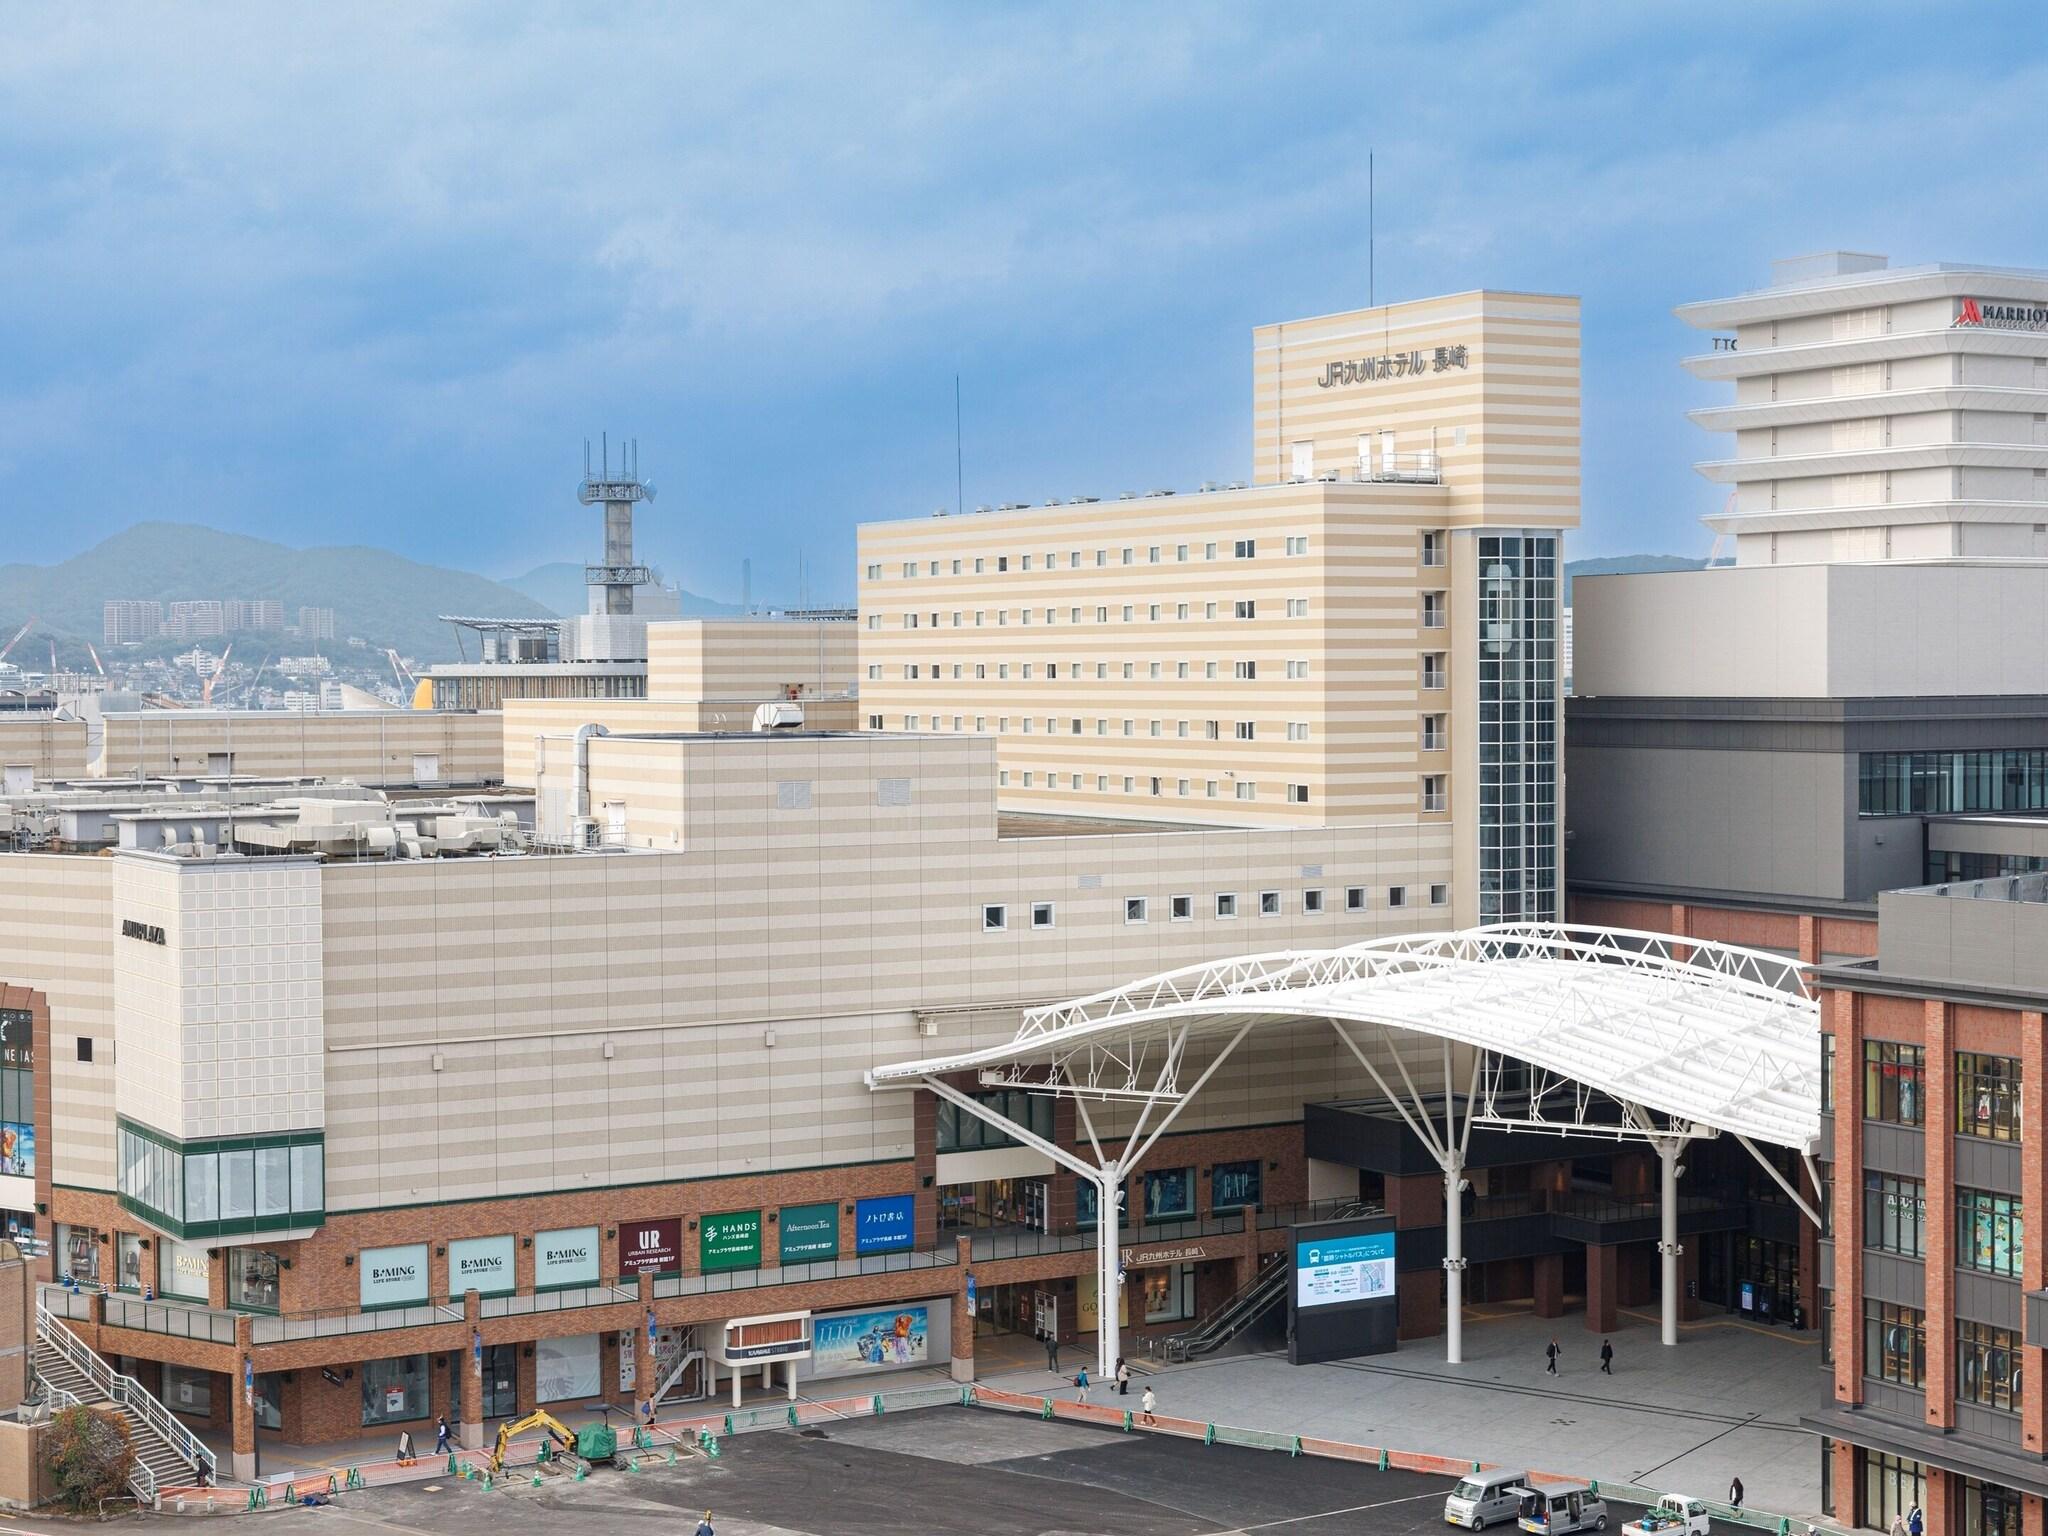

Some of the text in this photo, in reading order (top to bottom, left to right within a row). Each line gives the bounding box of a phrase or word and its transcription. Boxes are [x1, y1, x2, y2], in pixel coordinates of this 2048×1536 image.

[1318, 344, 1468, 388] JR九州ホテル 長崎
[1224, 1172, 1248, 1199] GAP
[722, 1222, 757, 1234] HANDS
[786, 1223, 819, 1233] Afternoon
[639, 1230, 660, 1250] UR
[645, 1247, 672, 1255] RESEARCH
[820, 1325, 853, 1343] 11.10
